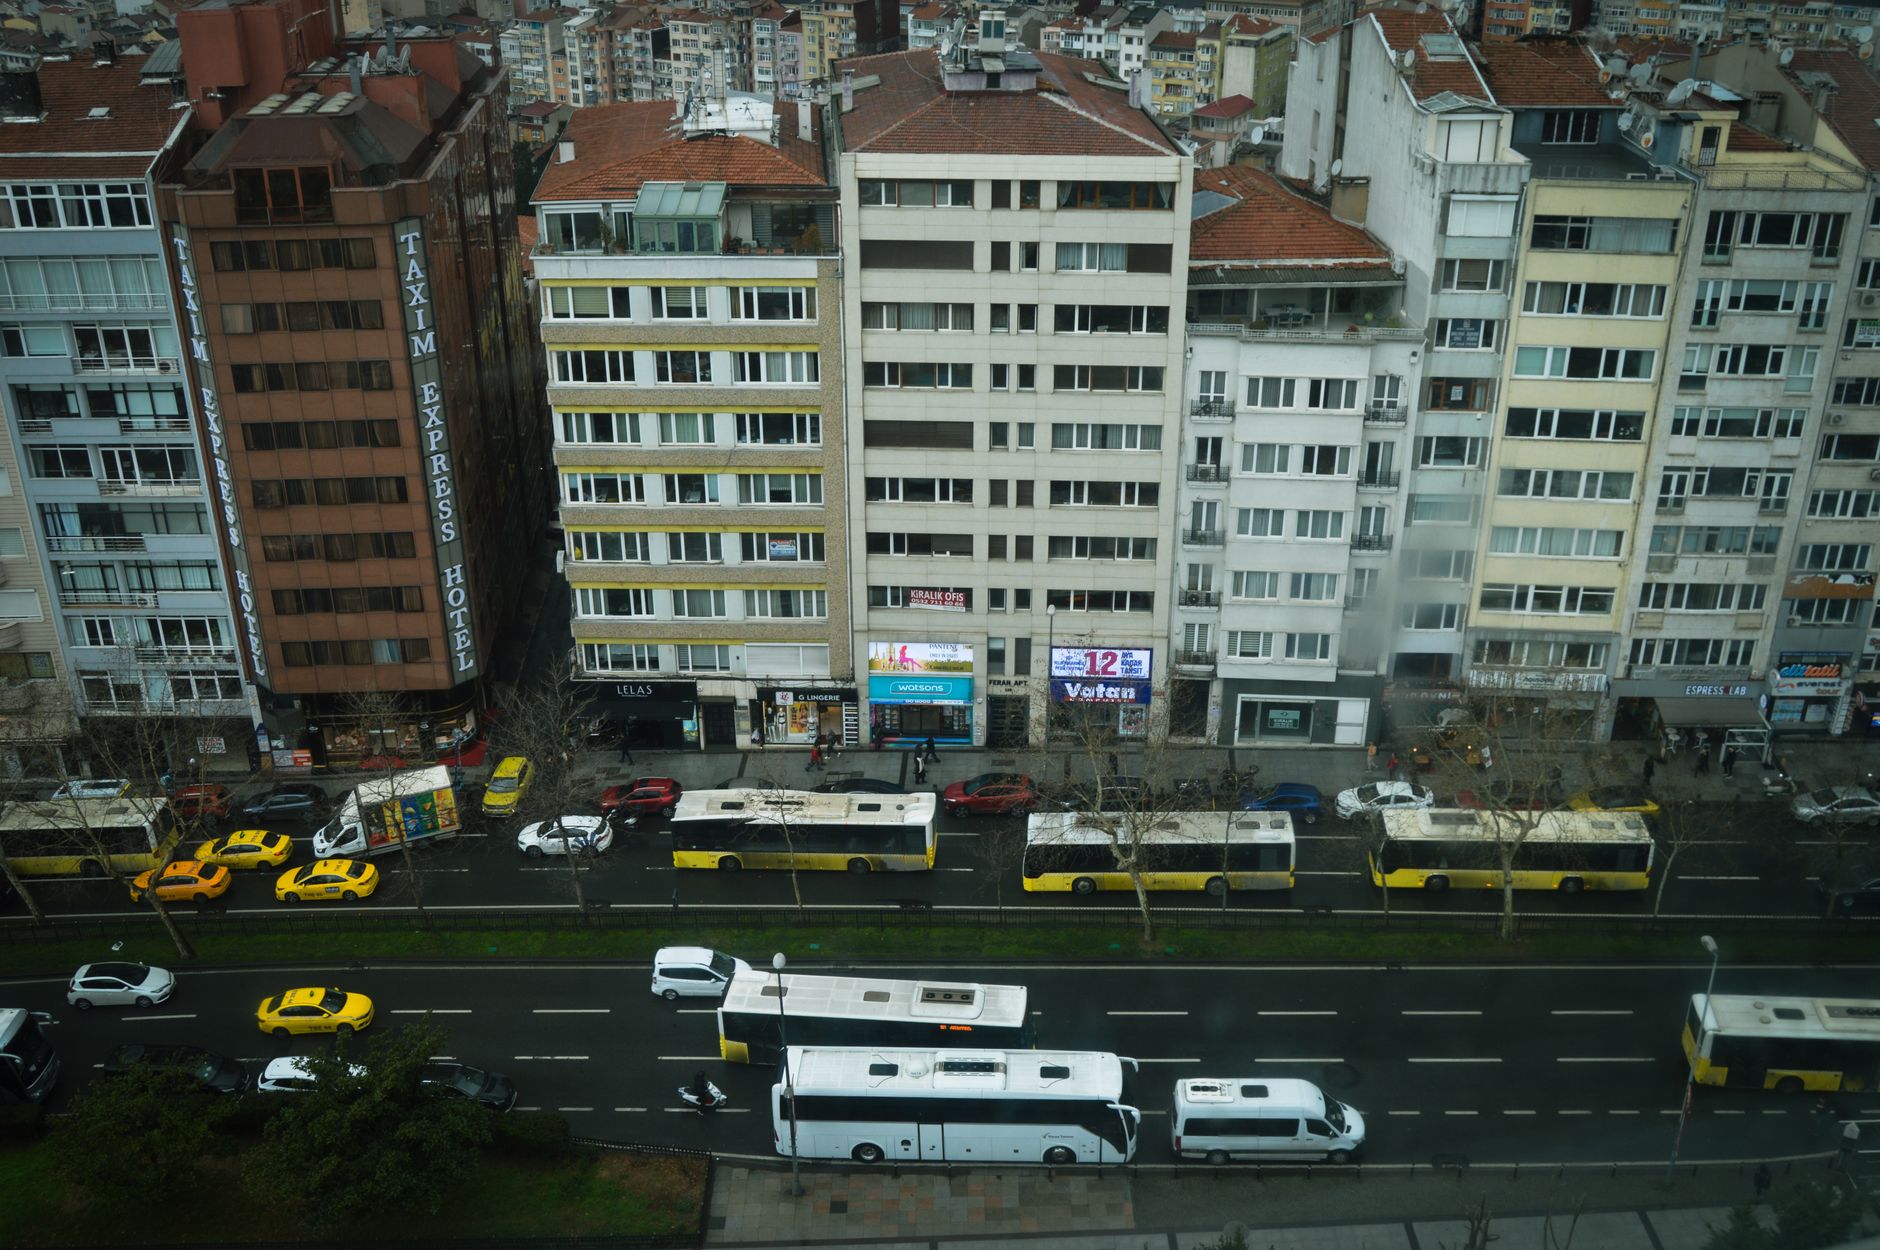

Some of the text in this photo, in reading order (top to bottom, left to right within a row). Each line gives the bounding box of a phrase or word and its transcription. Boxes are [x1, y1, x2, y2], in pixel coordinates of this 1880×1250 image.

[173, 236, 267, 678] TAXIM EXPRESS HOTEL
[400, 231, 475, 672] TAXIM EXPRESS HOTEL
[1084, 651, 1118, 676] 12
[616, 685, 653, 695] LELAS
[898, 684, 945, 692] watsons
